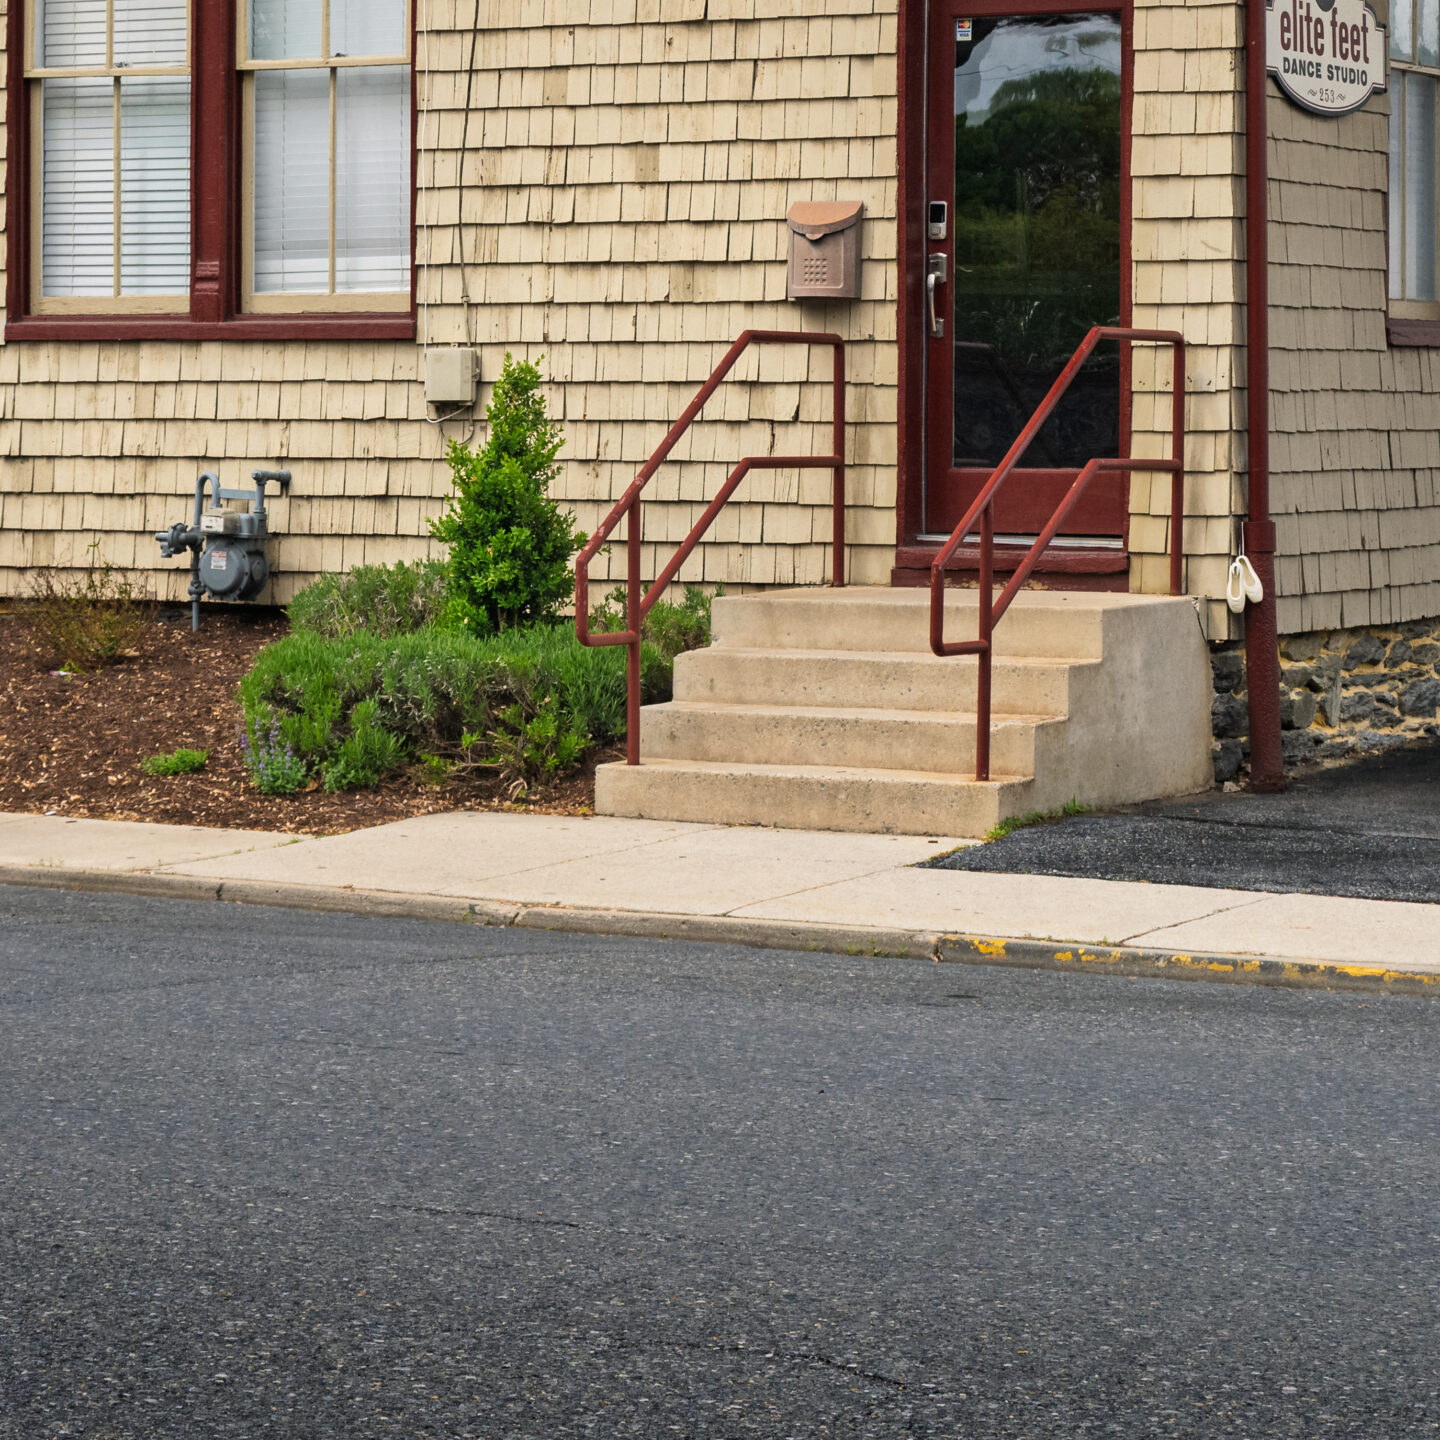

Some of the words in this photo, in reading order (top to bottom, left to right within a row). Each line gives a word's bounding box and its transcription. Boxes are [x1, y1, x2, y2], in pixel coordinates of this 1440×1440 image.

[1280, 0, 1325, 56] elite
[1331, 7, 1369, 64] feet
[1283, 57, 1322, 78] DANCE
[1327, 66, 1368, 87] STUDIO
[1319, 87, 1336, 103] 253
